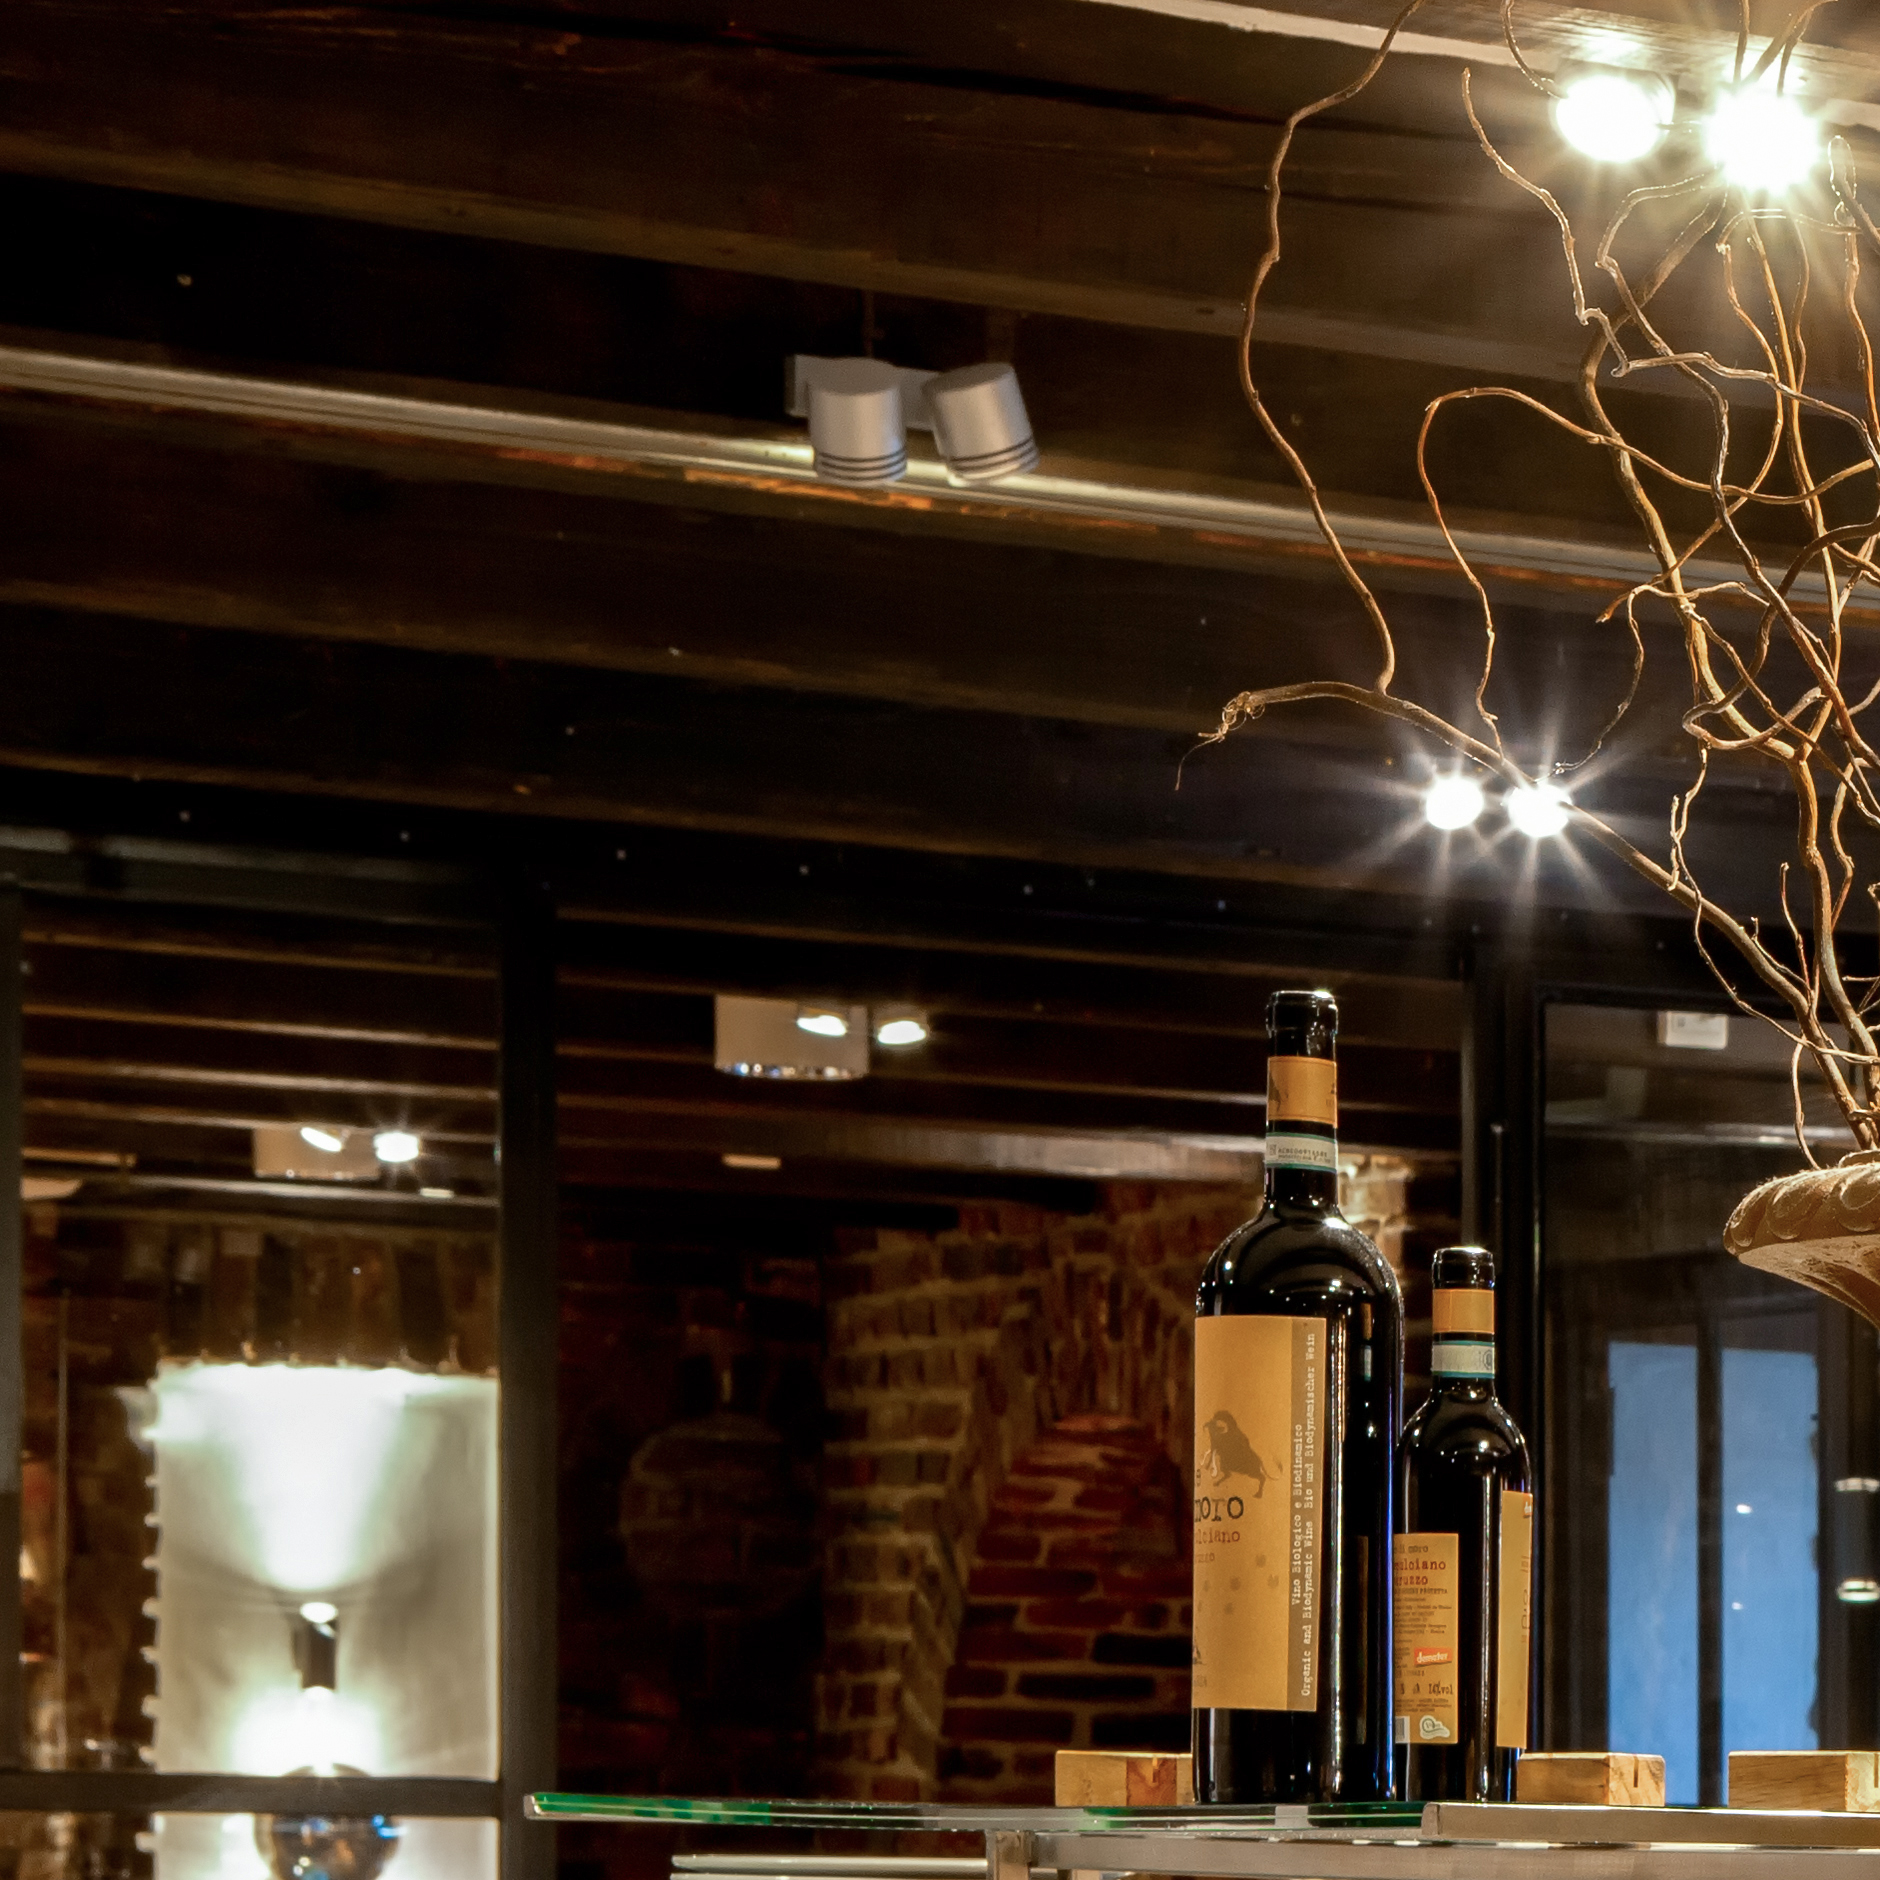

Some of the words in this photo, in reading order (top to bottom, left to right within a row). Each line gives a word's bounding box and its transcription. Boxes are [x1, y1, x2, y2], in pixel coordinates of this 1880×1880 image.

[1306, 1333, 1315, 1360] Wein
[1305, 1366, 1316, 1457] Biodynamischer
[1293, 1424, 1303, 1496] Biodinamico
[1305, 1463, 1314, 1482] und
[1304, 1489, 1313, 1509] Bio
[1292, 1515, 1303, 1574] Biologico
[1303, 1521, 1313, 1548] Wine
[1292, 1579, 1301, 1605] Vino
[1303, 1553, 1314, 1619] Biodynamic
[1303, 1624, 1312, 1645] and
[1301, 1650, 1313, 1696] Organic
